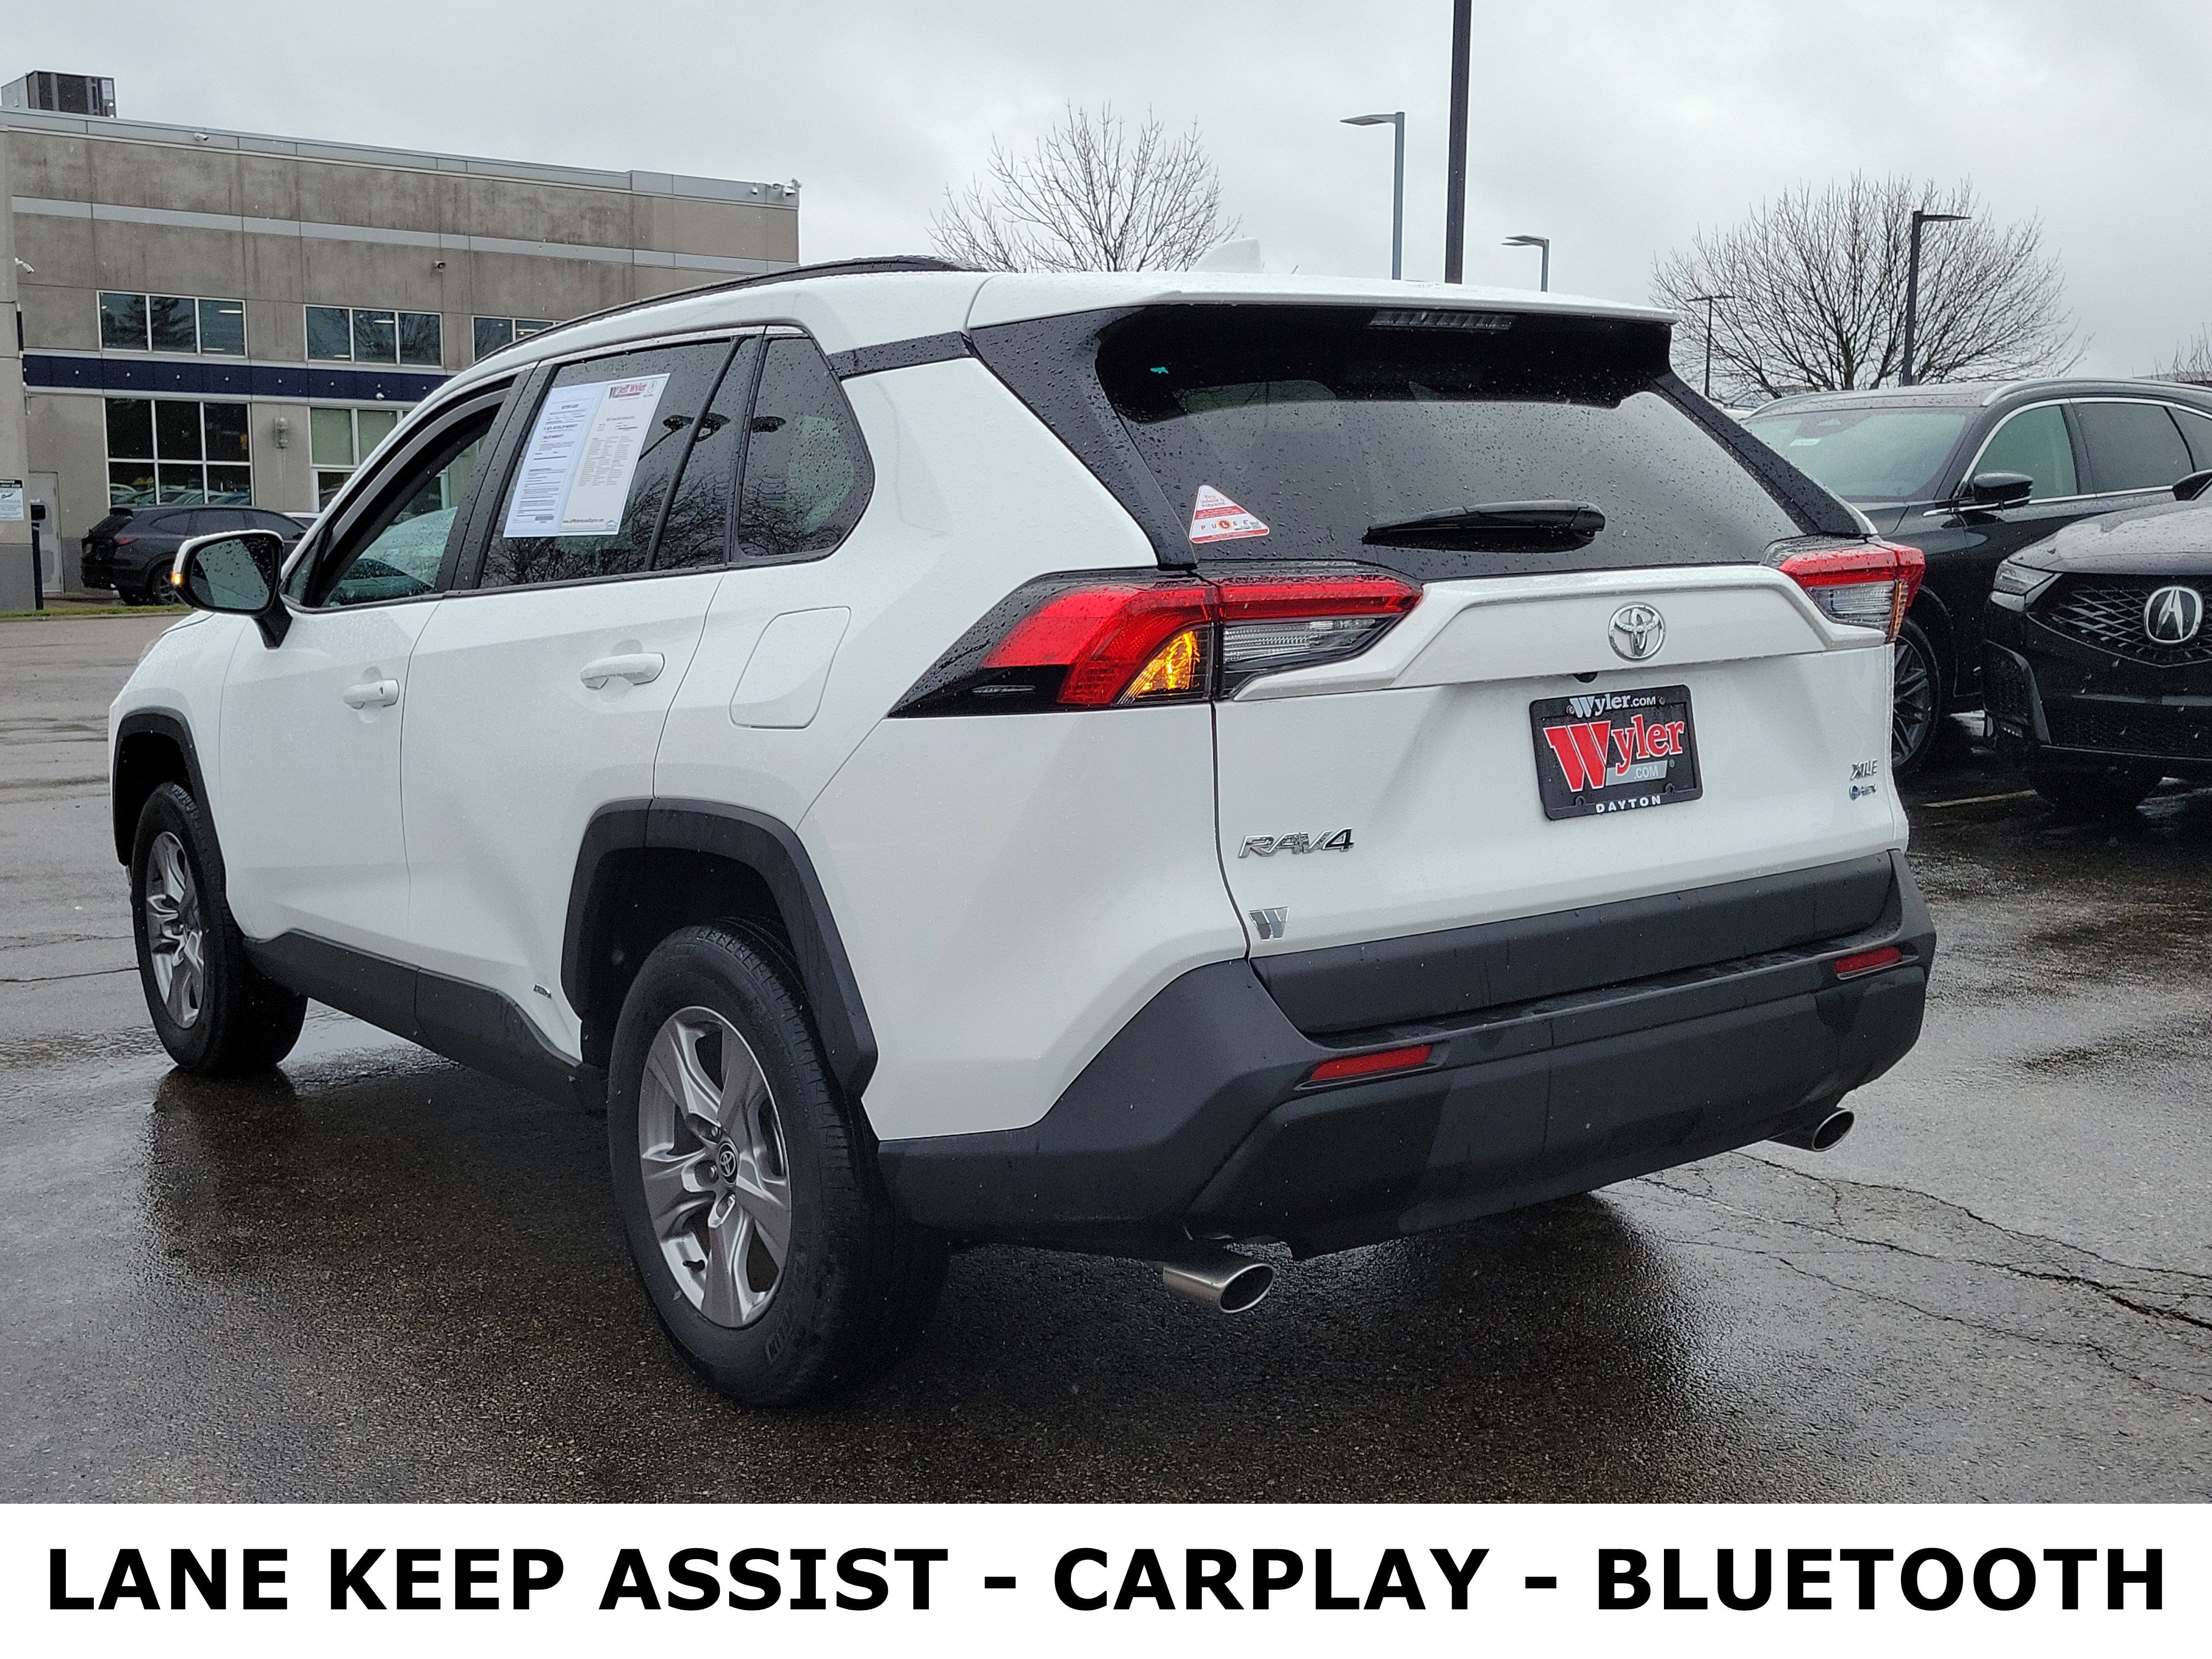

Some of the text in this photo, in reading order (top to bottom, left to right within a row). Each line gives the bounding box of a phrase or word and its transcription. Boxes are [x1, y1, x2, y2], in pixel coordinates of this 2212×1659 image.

[1201, 520, 1249, 530] PULSE
[1542, 714, 1685, 793] Wyler
[1633, 765, 1659, 780] .COM
[1595, 795, 1662, 813] DAYTON
[1238, 827, 1355, 858] RAV4
